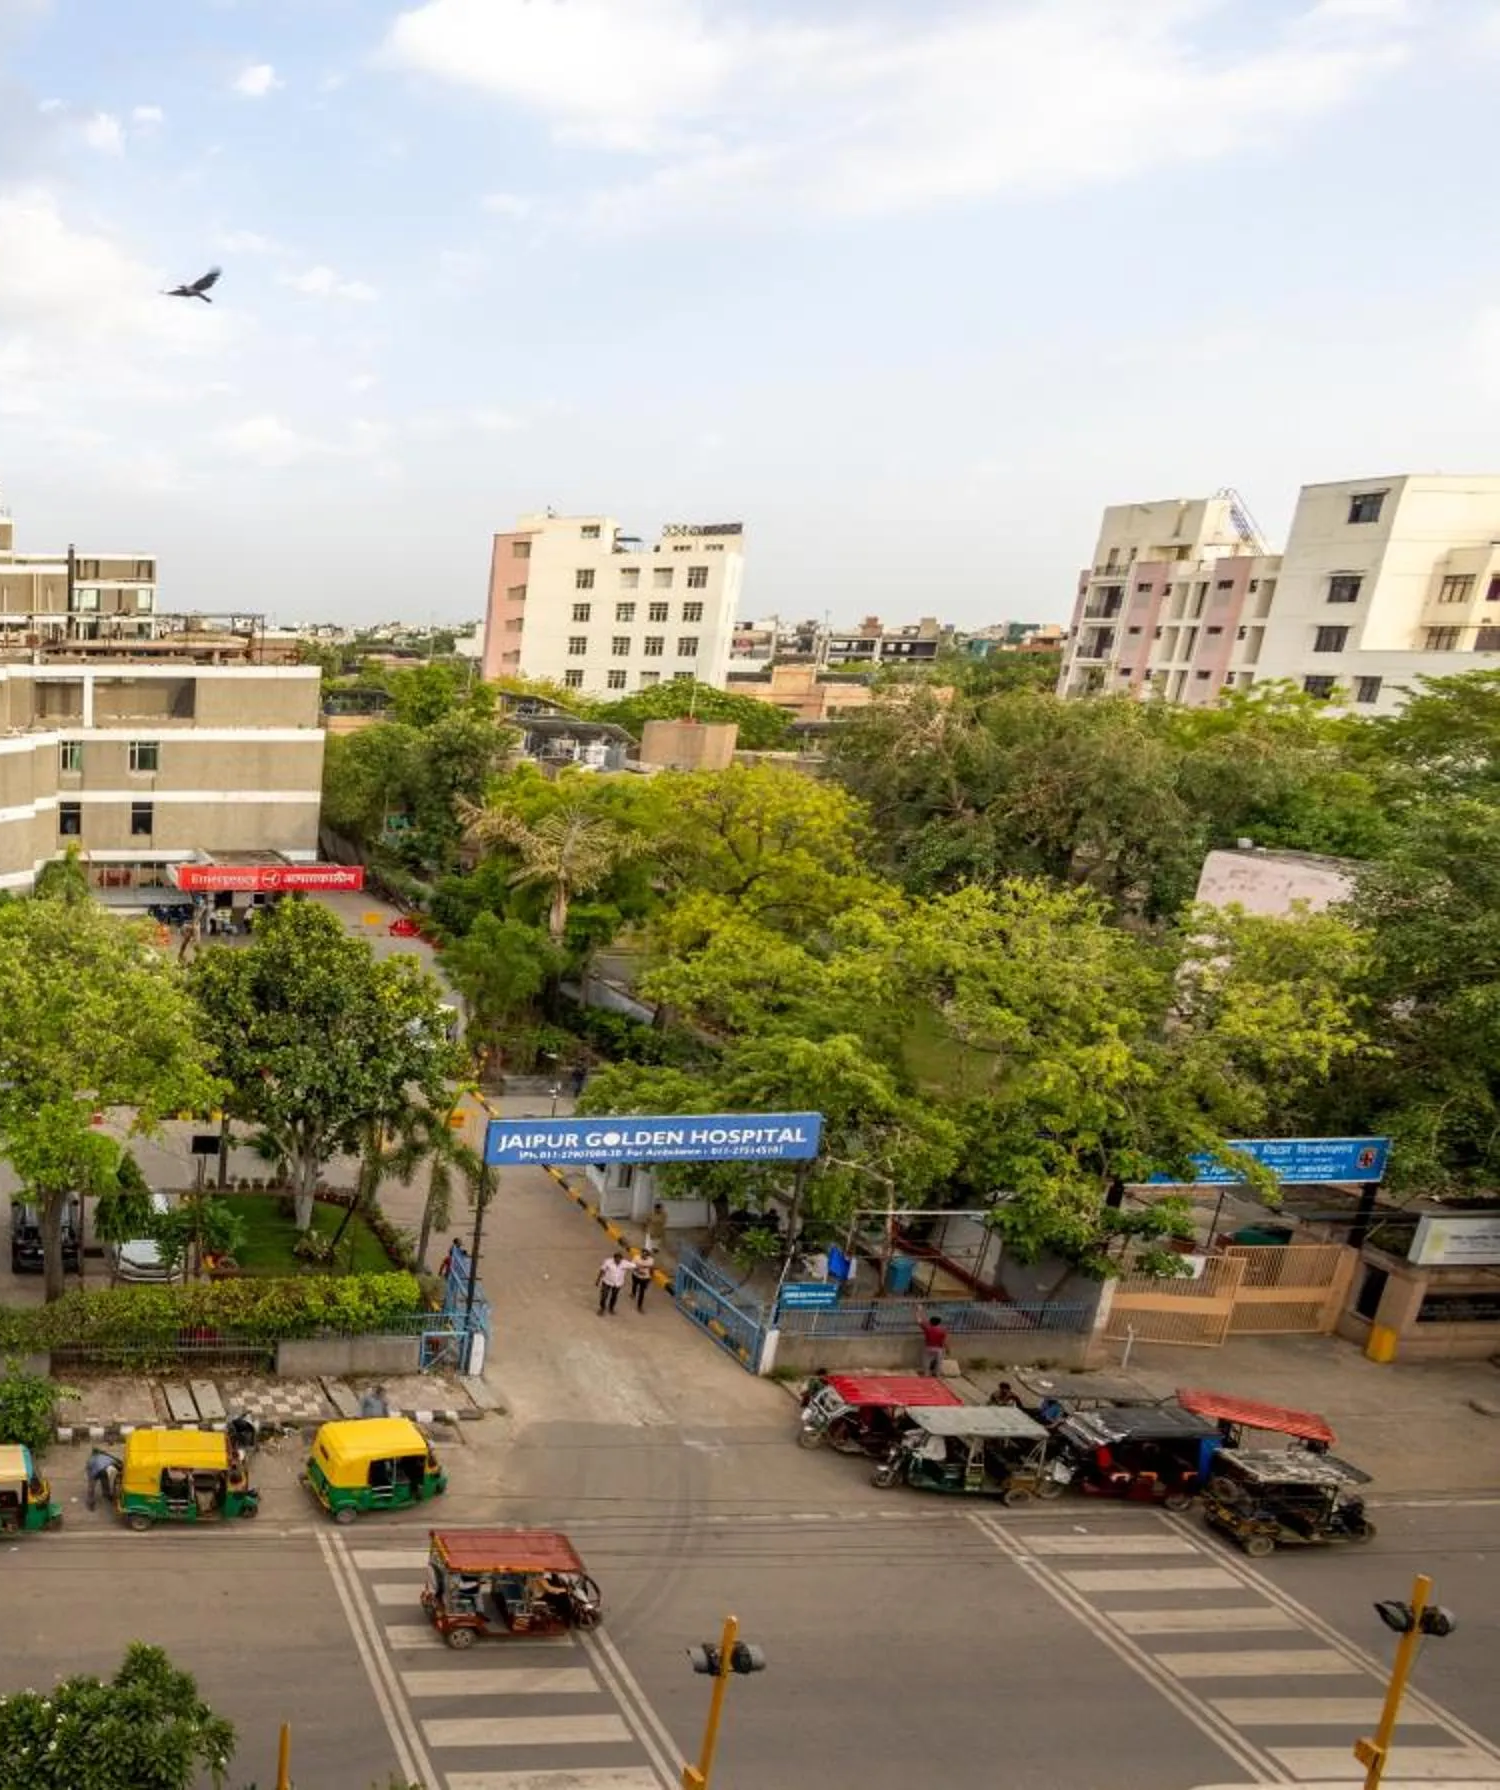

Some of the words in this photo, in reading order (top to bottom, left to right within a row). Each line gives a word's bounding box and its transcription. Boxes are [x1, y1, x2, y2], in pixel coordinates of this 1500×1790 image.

[191, 873, 256, 887] Emergency
[499, 1133, 578, 1152] JAIPUR
[586, 1131, 684, 1147] GOLDEN
[691, 1128, 807, 1144] HOSPITAL
